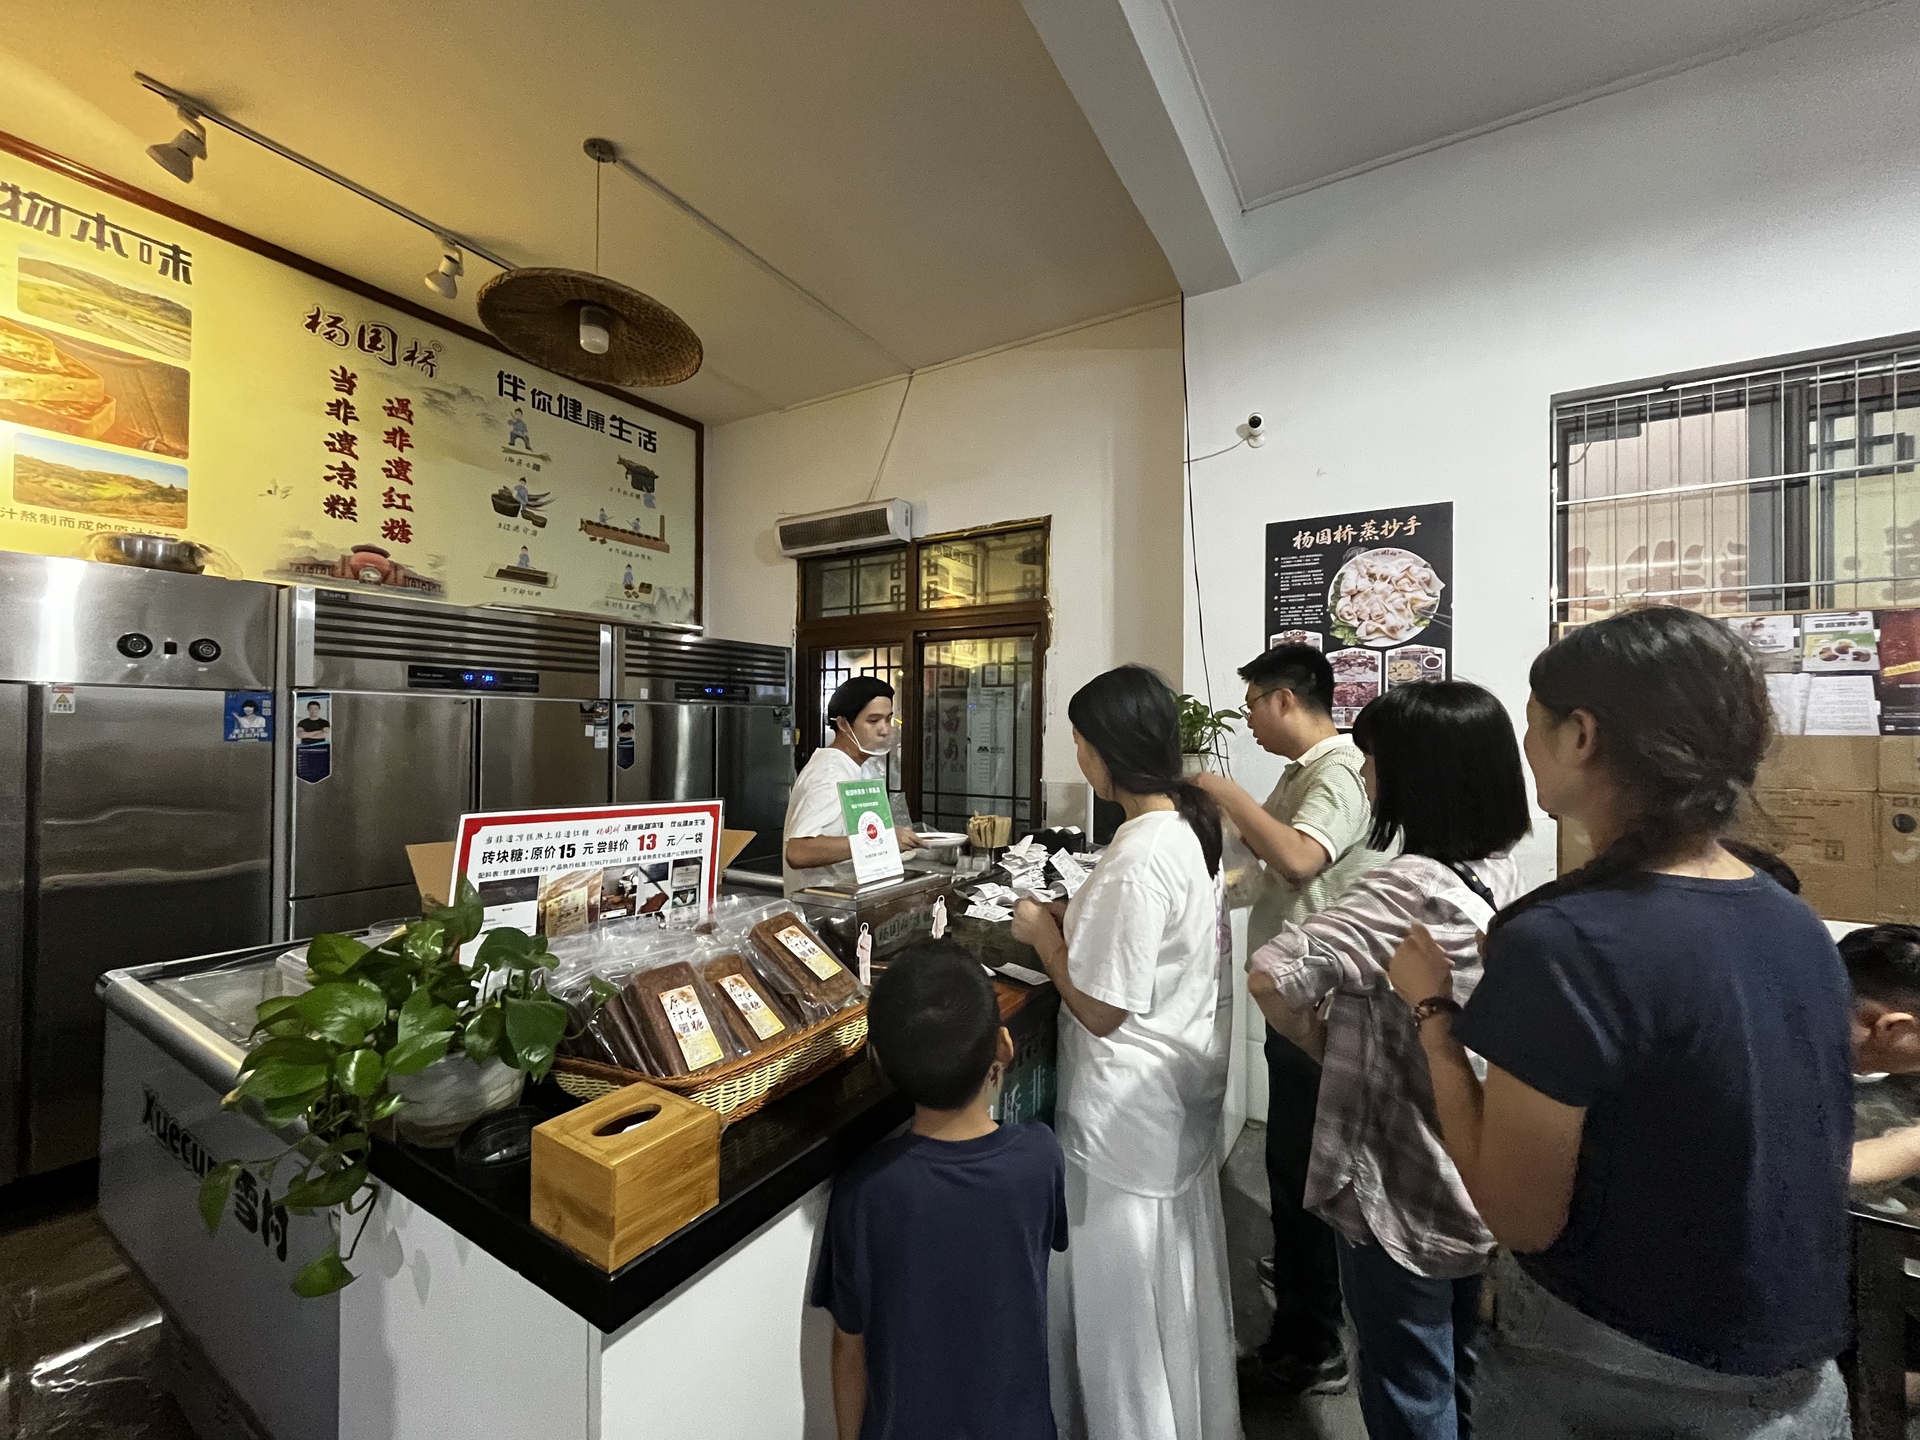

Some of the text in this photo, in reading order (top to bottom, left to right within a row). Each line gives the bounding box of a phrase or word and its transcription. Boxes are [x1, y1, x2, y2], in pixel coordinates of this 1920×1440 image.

[323, 365, 360, 523] 当非遗凉糕
[497, 369, 658, 454] 伴你健康生活
[381, 397, 414, 544] 遇非遗红糖
[1292, 515, 1422, 549] 杨国桥蒸抄手
[637, 833, 658, 851] 13
